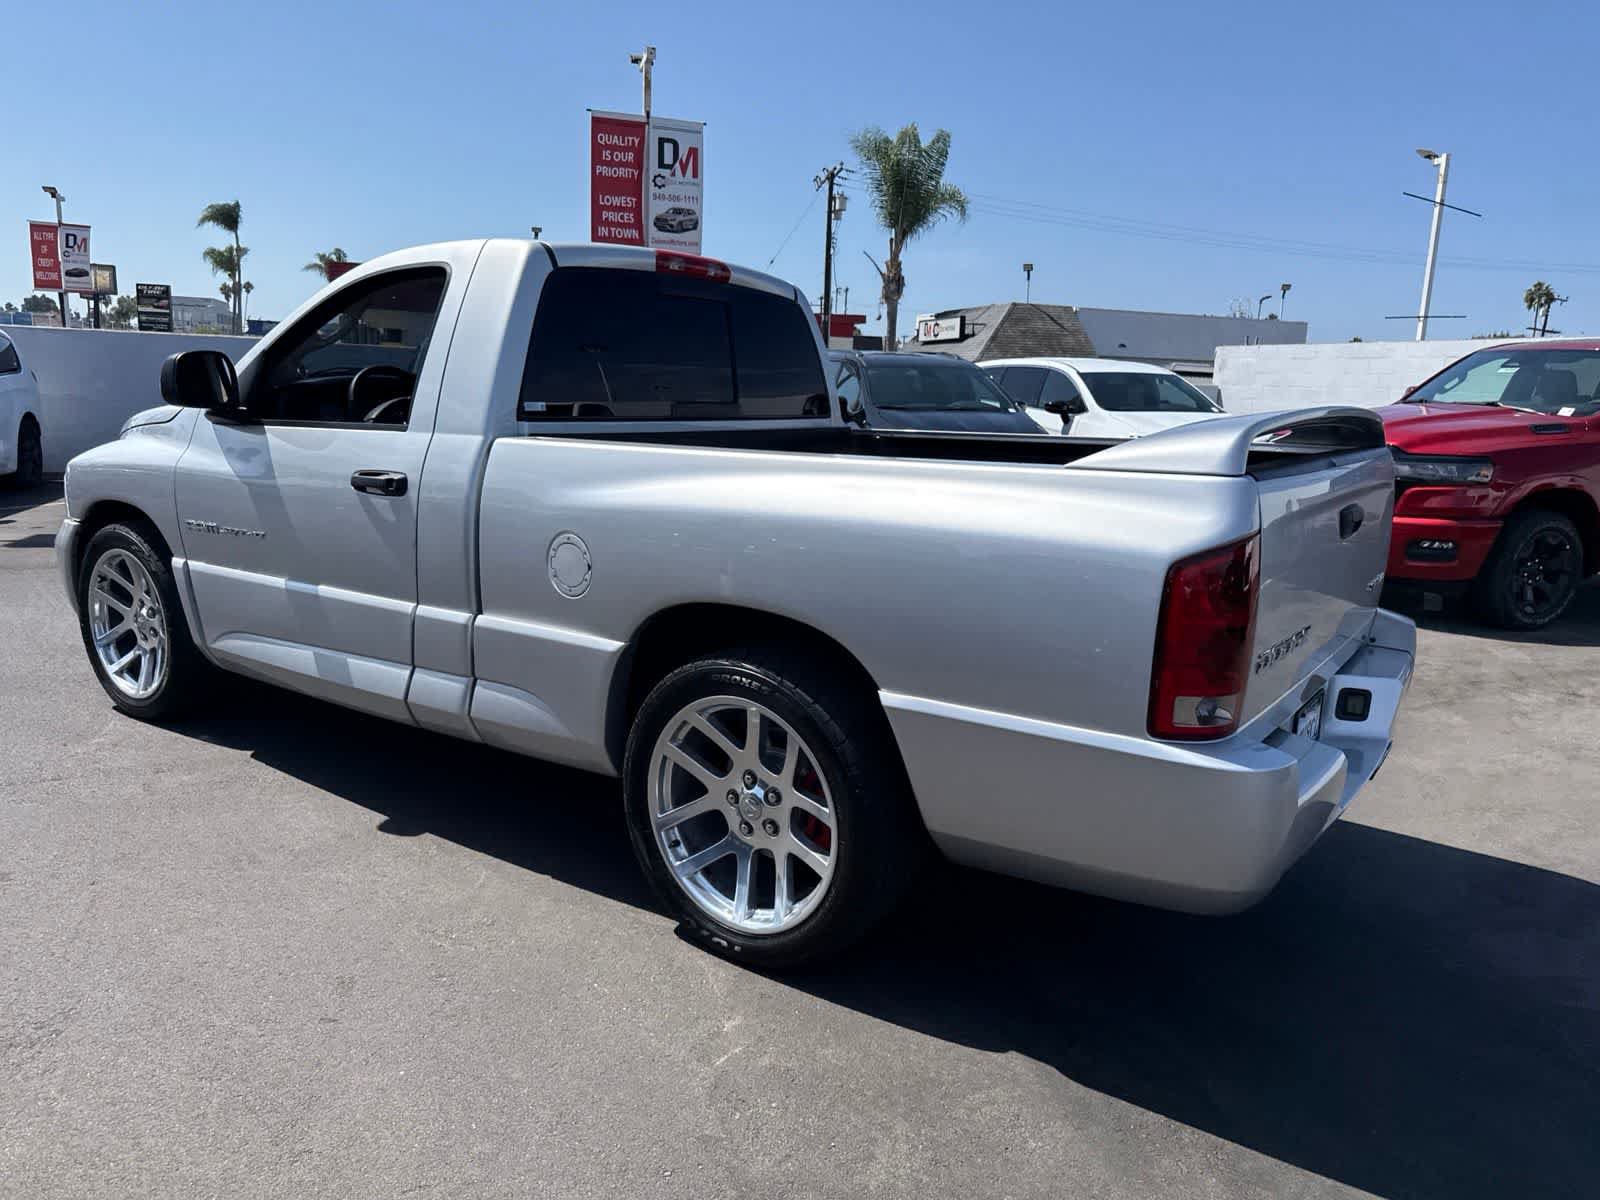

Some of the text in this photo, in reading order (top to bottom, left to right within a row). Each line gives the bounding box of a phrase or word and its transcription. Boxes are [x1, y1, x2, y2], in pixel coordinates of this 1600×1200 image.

[597, 133, 640, 147] QUALITY
[602, 150, 634, 163] IS OUR
[596, 165, 639, 180] PRIORITY
[599, 194, 637, 208] LOWEST
[602, 211, 634, 223] PRICES
[598, 227, 639, 239] IN TOWN
[35, 271, 59, 281] WELCOME
